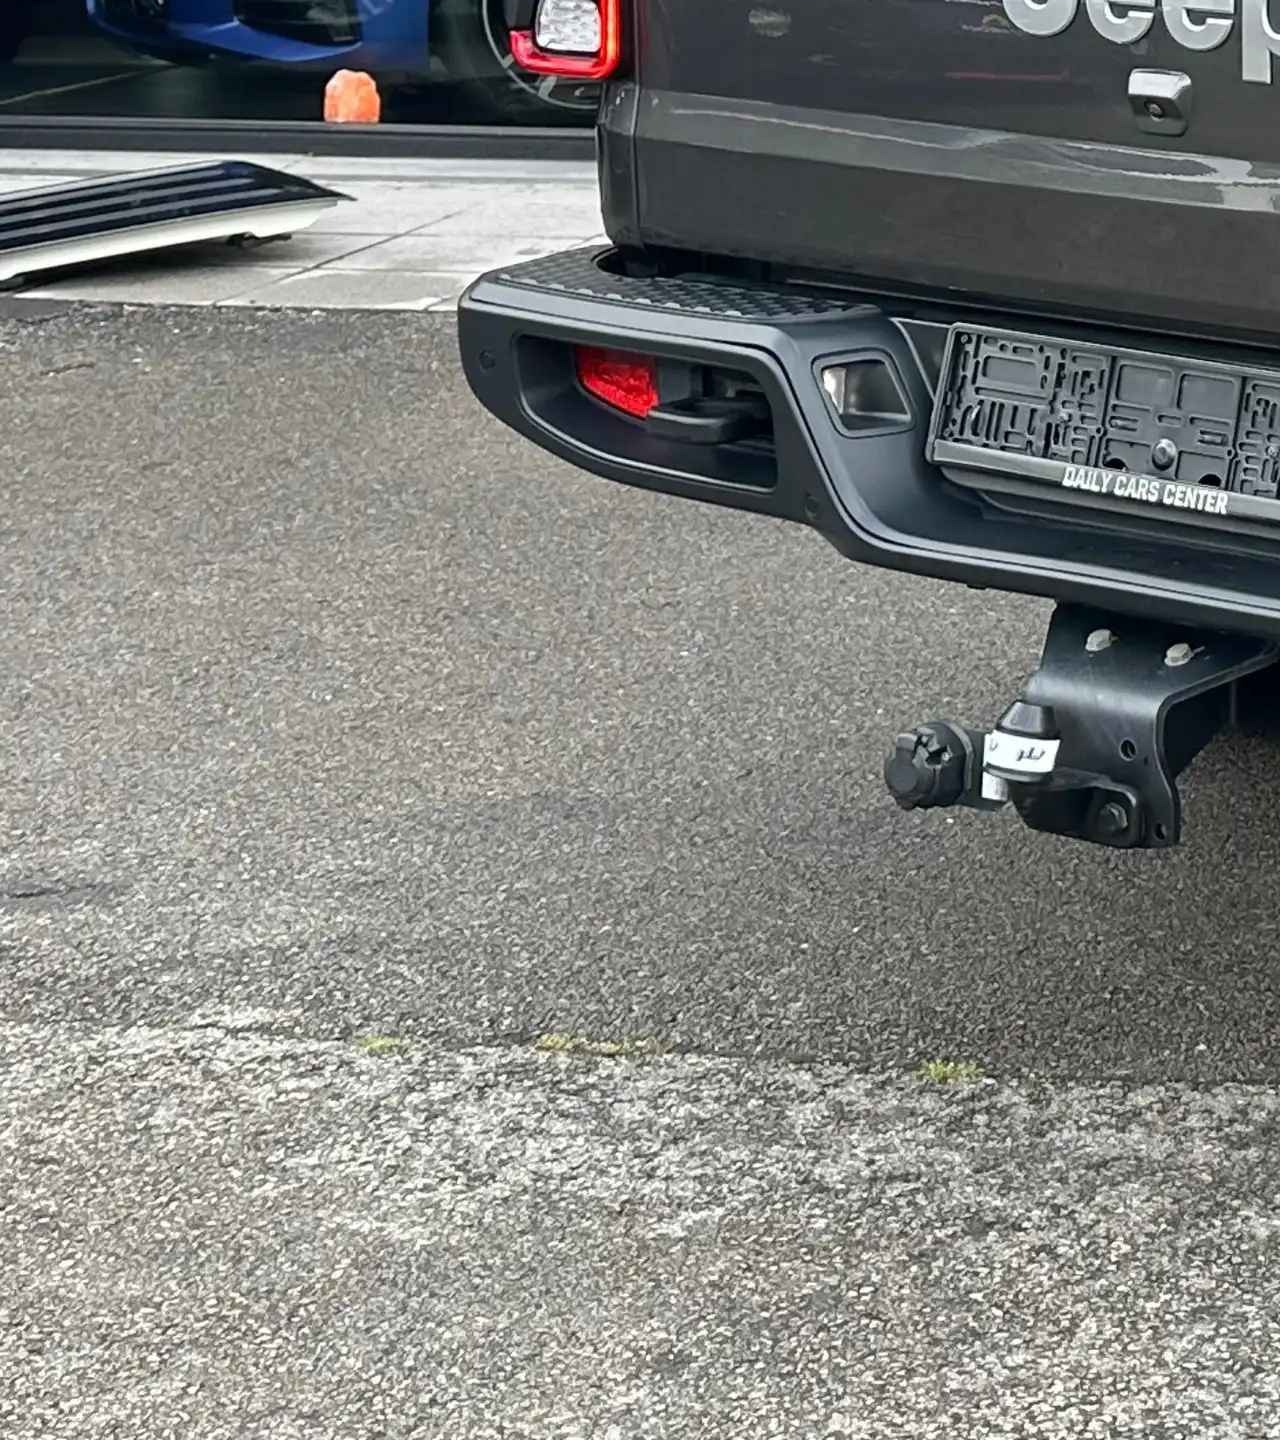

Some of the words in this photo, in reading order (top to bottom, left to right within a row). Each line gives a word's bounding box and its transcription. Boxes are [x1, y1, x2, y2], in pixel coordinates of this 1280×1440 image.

[1062, 465, 1112, 493] DAILY
[1113, 475, 1159, 502] CARS
[1163, 484, 1229, 514] CENTER
